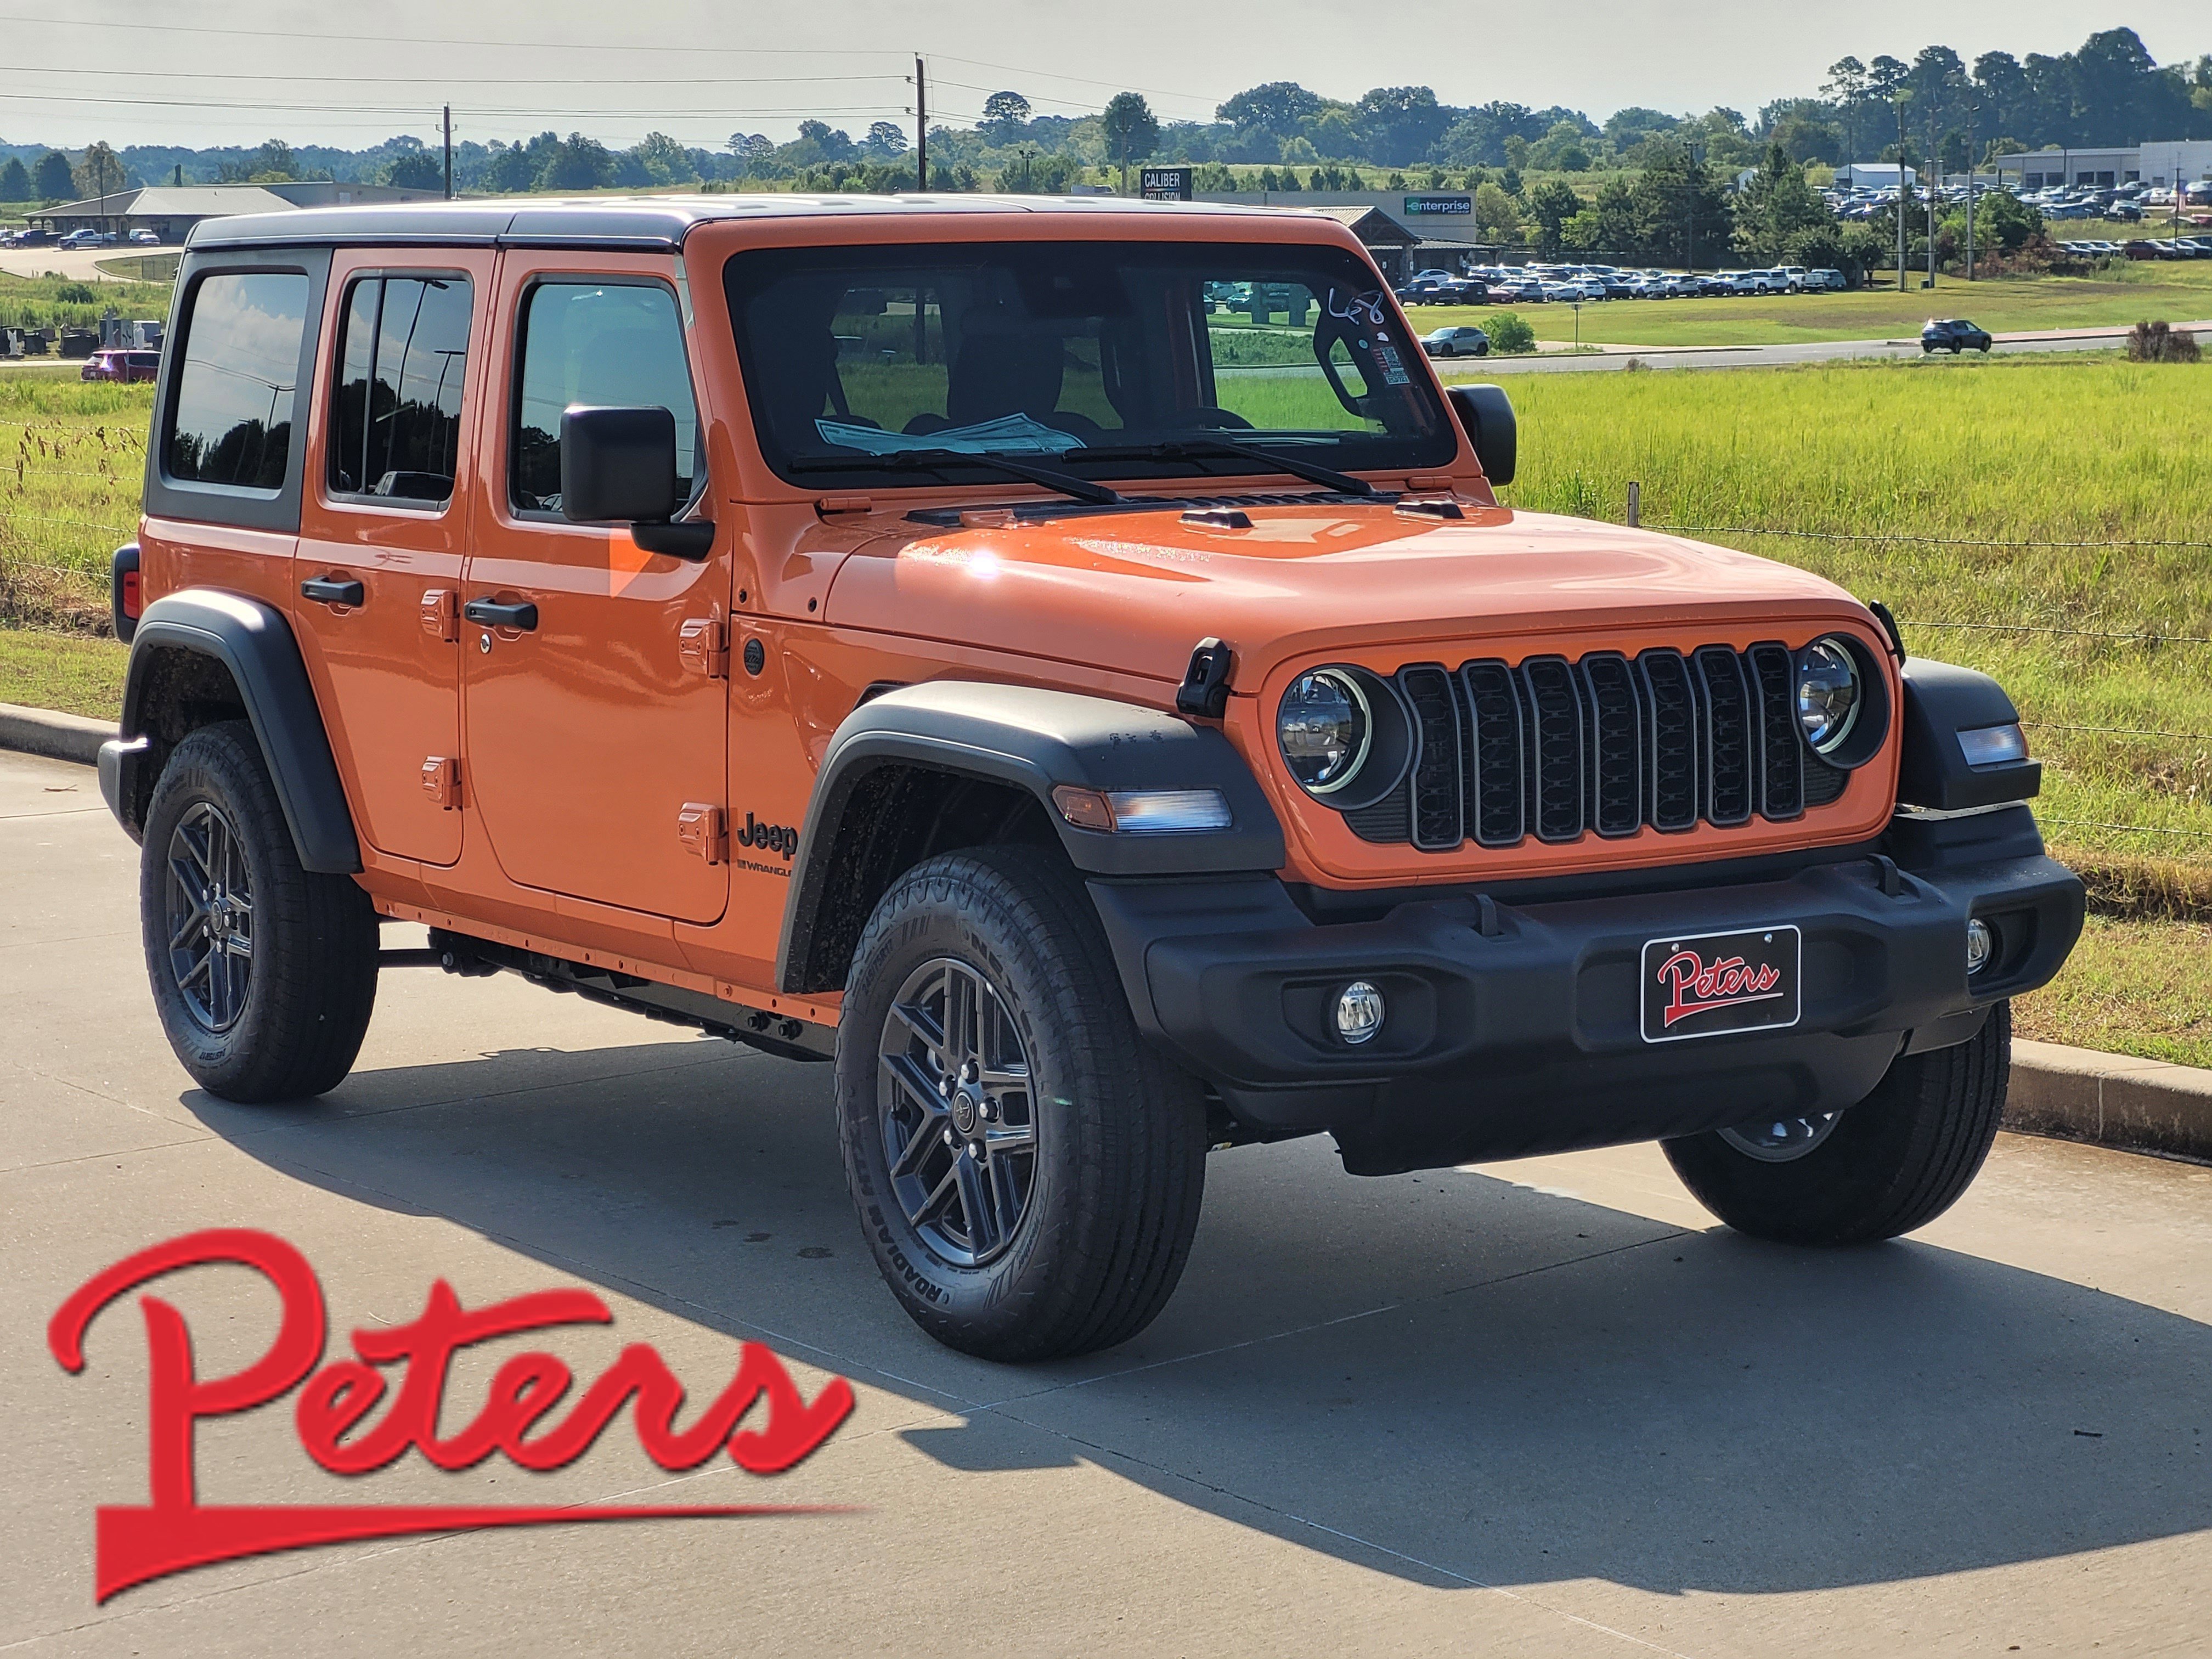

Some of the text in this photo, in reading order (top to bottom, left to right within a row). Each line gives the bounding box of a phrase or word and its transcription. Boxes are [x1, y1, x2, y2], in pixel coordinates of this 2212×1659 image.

[1144, 173, 1180, 188] CALIBER
[1407, 200, 1470, 213] enterprise
[737, 811, 798, 861] Jeep
[747, 861, 792, 877] WRANGL
[1657, 951, 1783, 1028] Peters
[867, 1204, 943, 1304] ROADIAN
